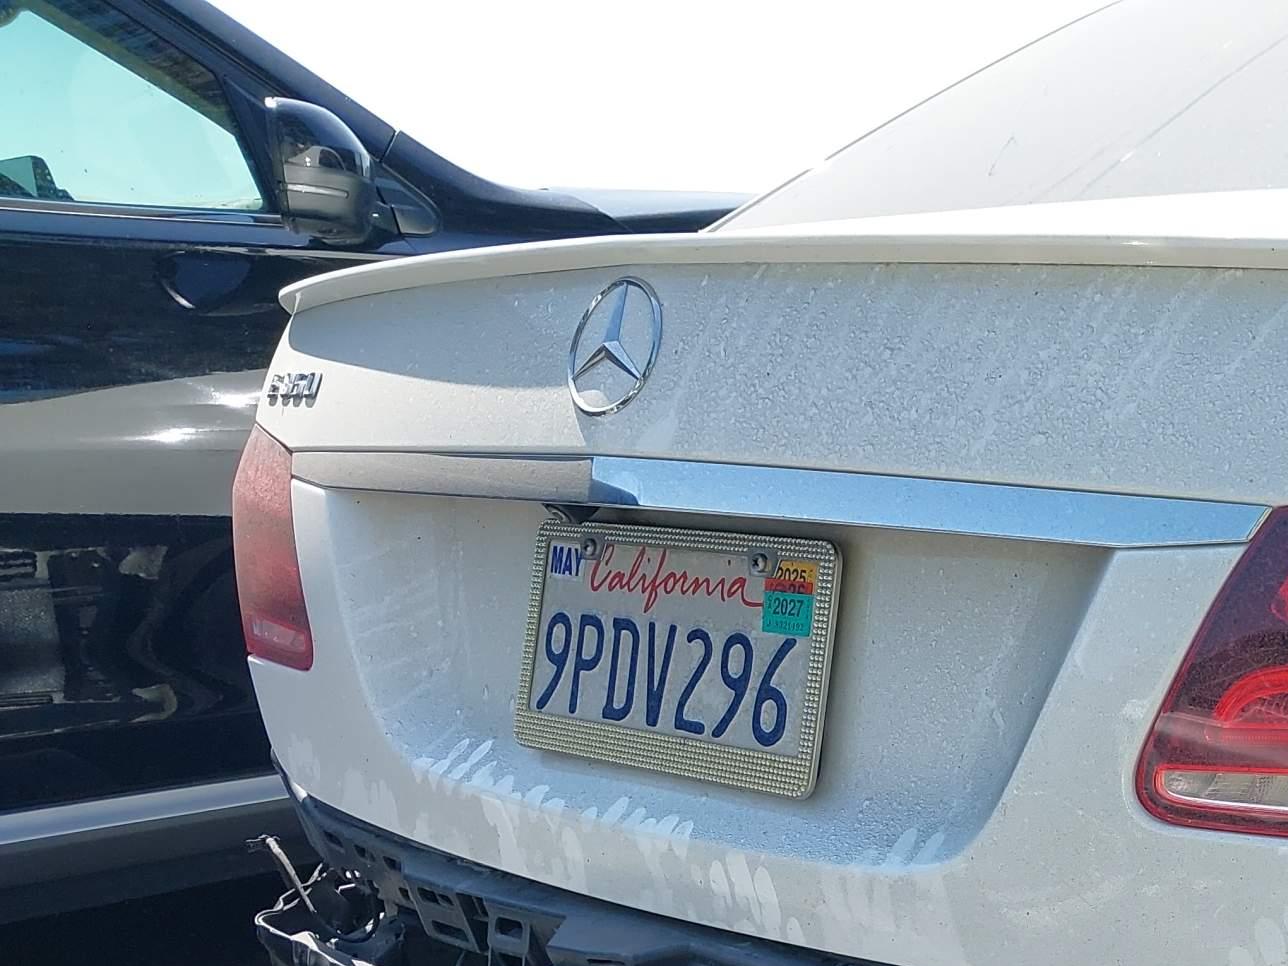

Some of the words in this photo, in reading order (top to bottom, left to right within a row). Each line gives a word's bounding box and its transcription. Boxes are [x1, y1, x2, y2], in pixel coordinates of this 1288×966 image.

[550, 545, 584, 576] MAY
[775, 566, 806, 583] 2025
[590, 543, 764, 613] California
[772, 597, 804, 617] 2027
[535, 611, 798, 748] 9PDV296
